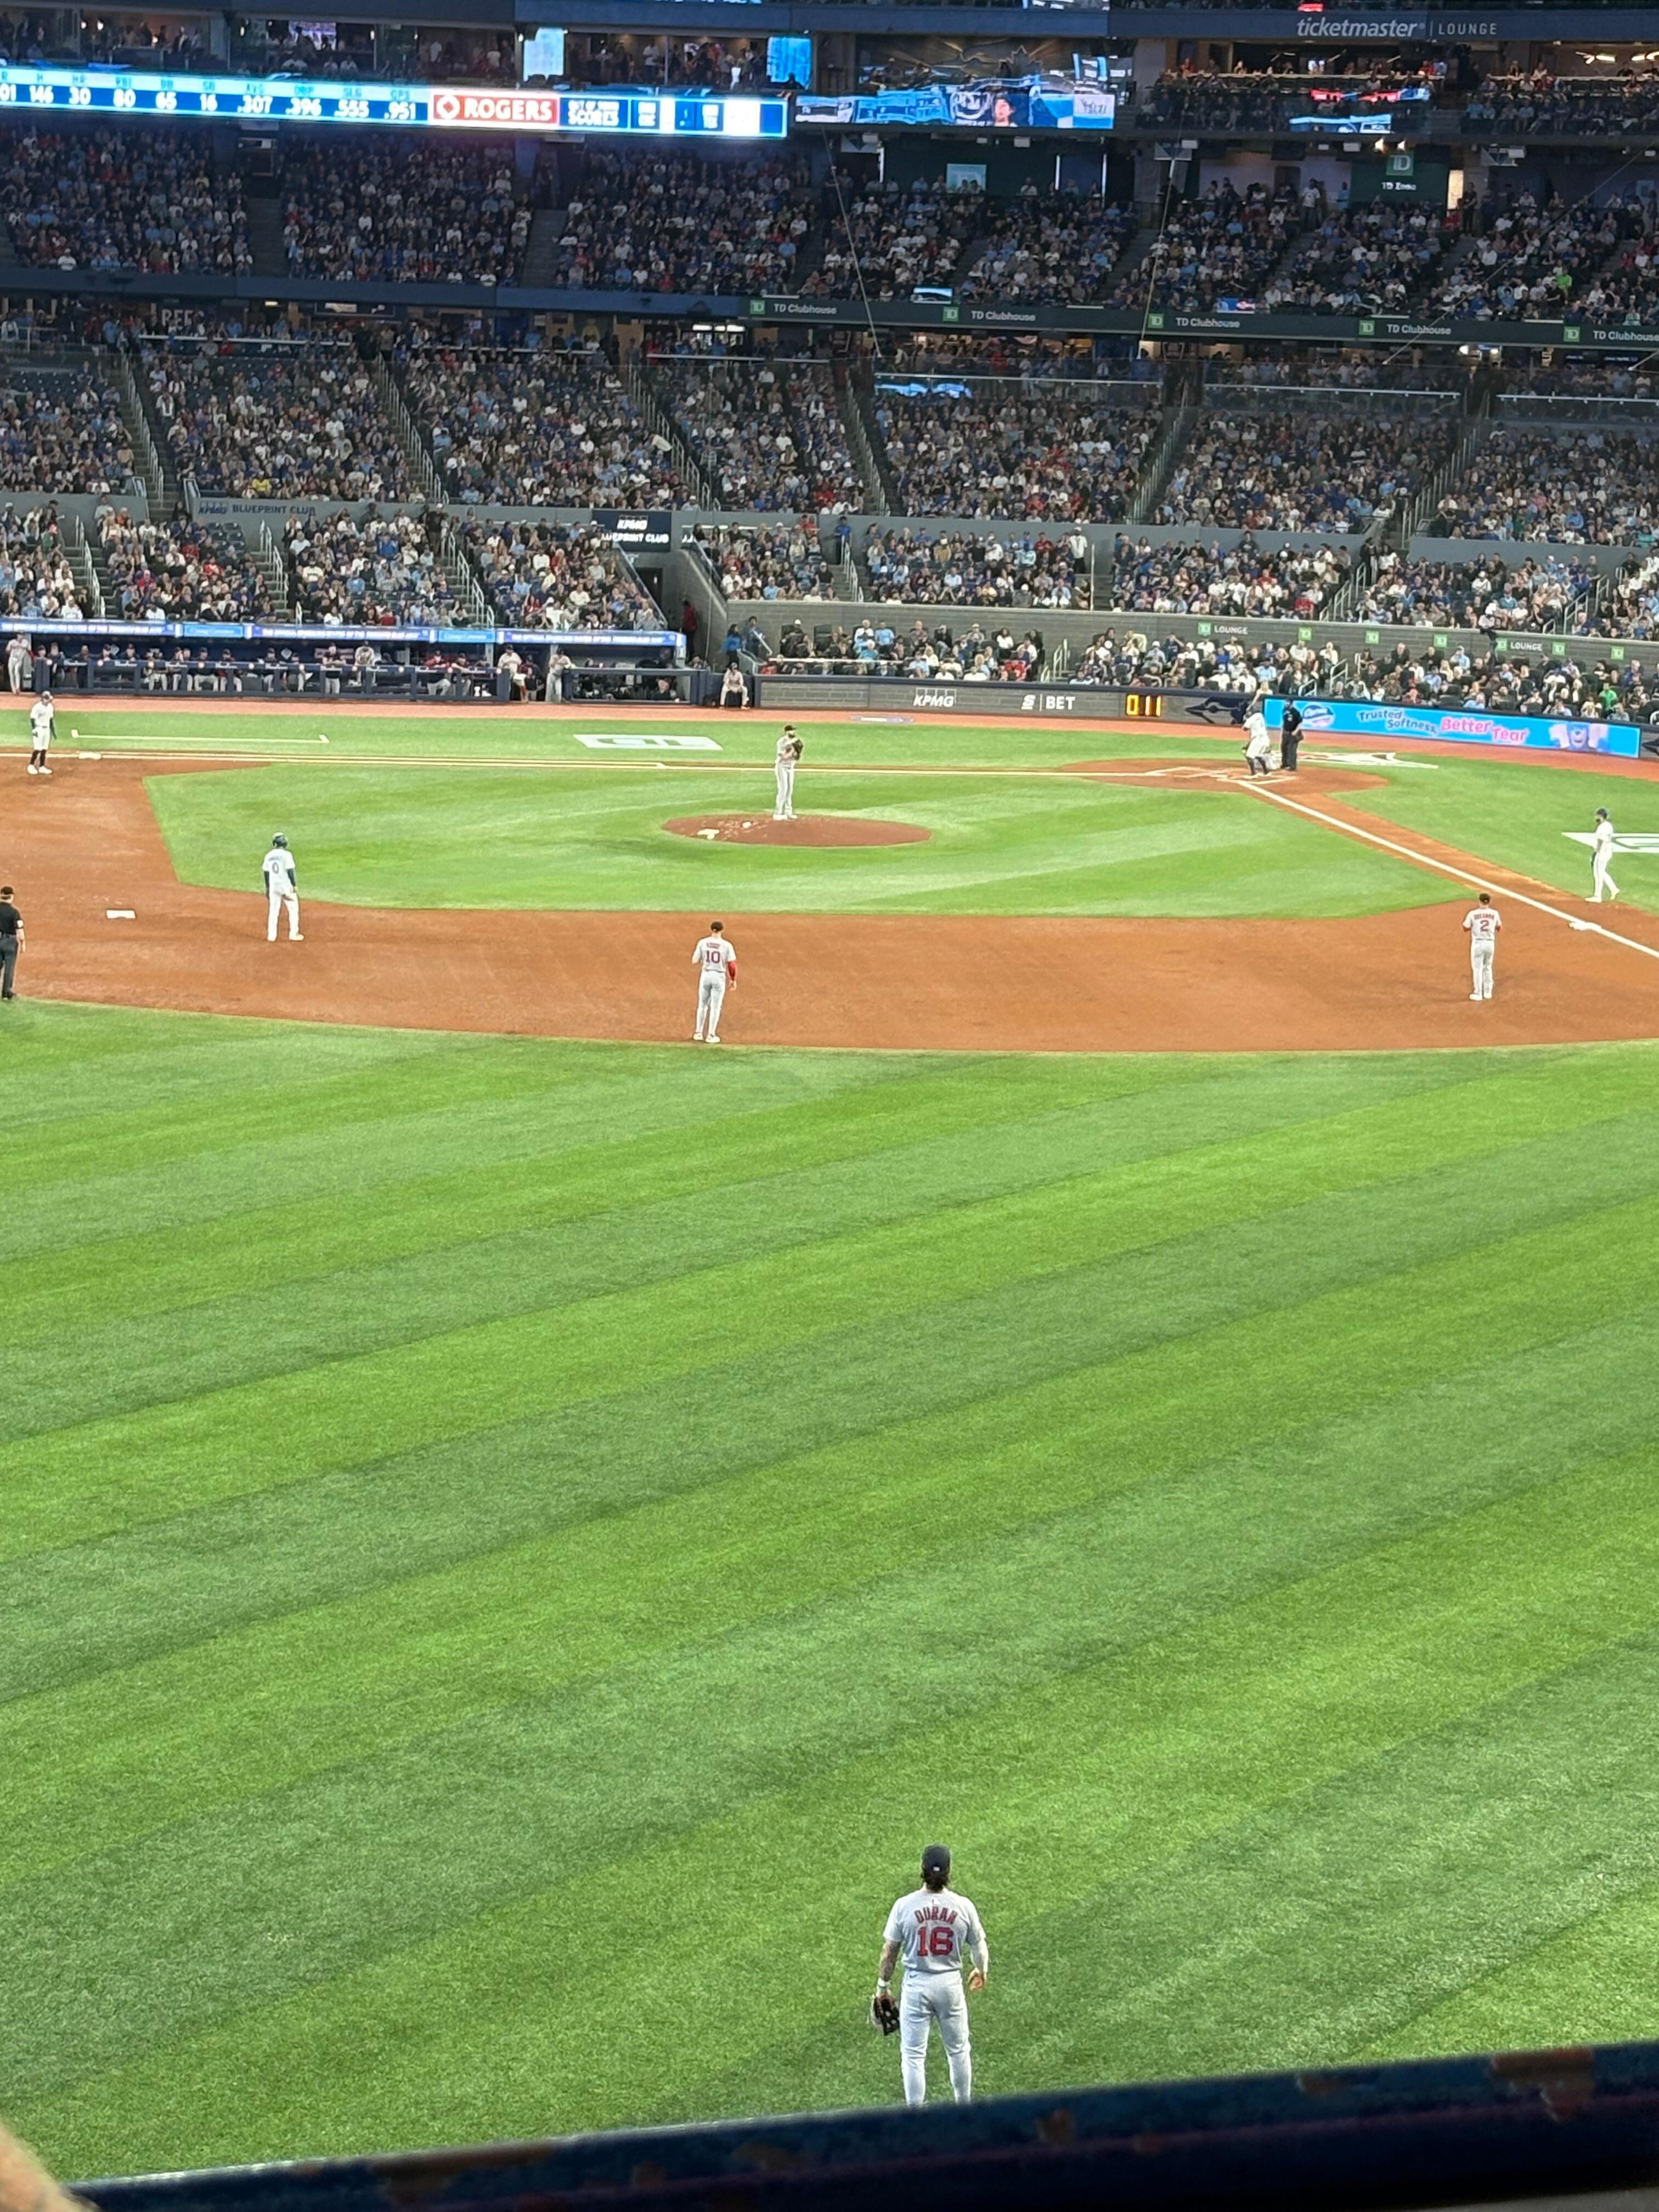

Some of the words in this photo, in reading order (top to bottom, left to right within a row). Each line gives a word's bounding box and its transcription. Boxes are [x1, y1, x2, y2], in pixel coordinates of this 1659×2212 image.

[1297, 17, 1418, 37] ticketmaster
[1438, 22, 1497, 35] LOUNGE
[37, 73, 43, 82] H
[29, 84, 54, 104] 146
[69, 86, 92, 105] 30
[113, 88, 137, 108] 80
[155, 91, 177, 110] 65
[200, 93, 218, 111] 16
[237, 94, 273, 115] .307
[285, 97, 323, 117] .396
[334, 99, 370, 119] .555
[384, 101, 417, 120] .951
[464, 98, 552, 122] ROGERS
[1390, 155, 1411, 171] TD
[1381, 182, 1393, 190] TD
[751, 303, 764, 312] TD
[774, 303, 786, 313] TD
[788, 304, 837, 314] Clubhouse
[944, 309, 957, 319] TD
[971, 310, 984, 319] TD
[985, 311, 1036, 321] Clubhouse
[1150, 316, 1162, 325] TD
[1176, 317, 1189, 327] TD
[1190, 317, 1240, 328] Clubhouse
[1361, 322, 1374, 332] TD
[1387, 324, 1400, 334] TD
[1401, 324, 1452, 335] Clubhouse
[1566, 330, 1578, 340] TD
[1593, 330, 1606, 340] TD
[232, 504, 287, 514] BLUEPRINT
[645, 533, 669, 543] CLUB
[1214, 625, 1248, 635] LOUNGE
[1510, 641, 1543, 652] LOUNGE
[913, 696, 954, 708] KPMG
[1046, 696, 1076, 710] BET
[1357, 709, 1403, 721] Trusted
[1441, 716, 1492, 733] Better
[1492, 727, 1528, 742] Tear
[1480, 919, 1489, 932] 2
[706, 950, 720, 963] 10
[914, 1906, 958, 1925] DURAN
[916, 1926, 953, 1956] 16
